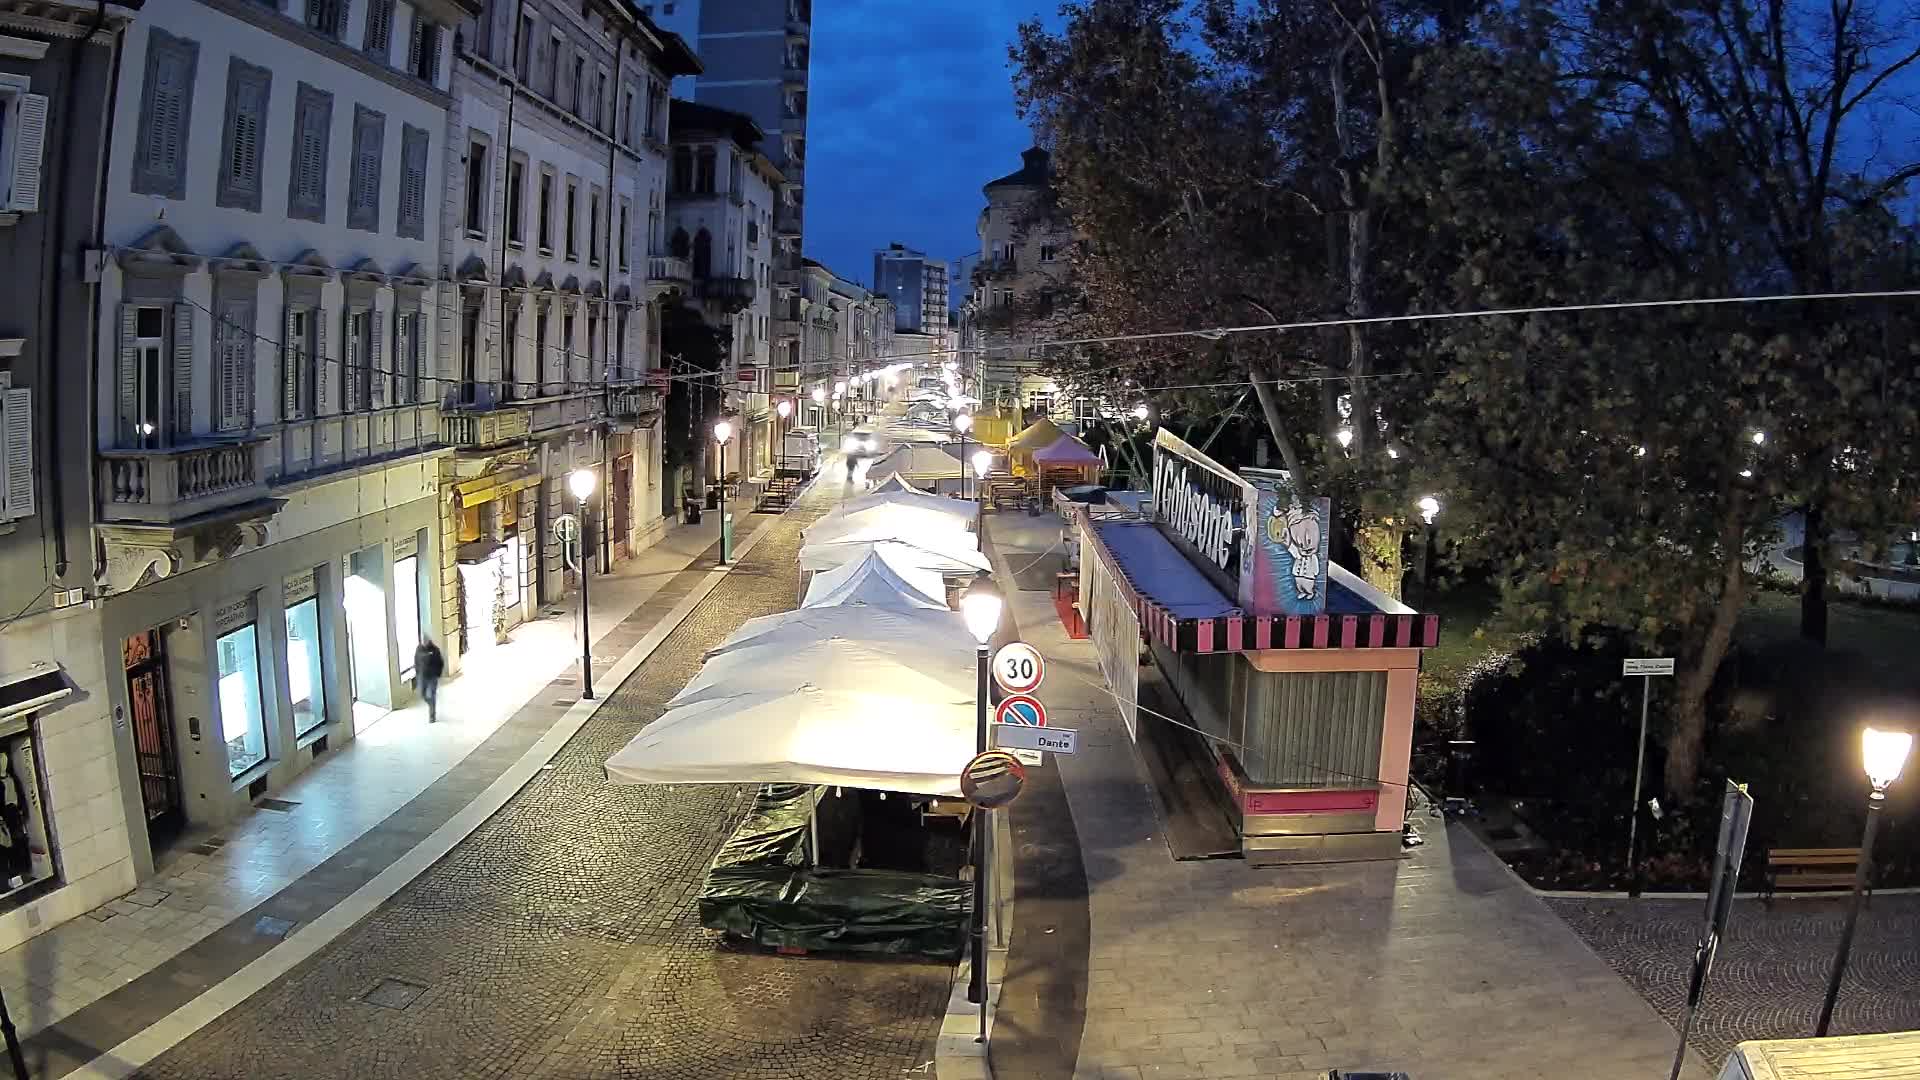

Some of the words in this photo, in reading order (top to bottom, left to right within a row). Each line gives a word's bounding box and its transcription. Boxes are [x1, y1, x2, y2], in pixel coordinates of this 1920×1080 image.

[1162, 458, 1233, 570] Golosone
[1006, 658, 1033, 680] 30
[1038, 737, 1070, 748] Dante
